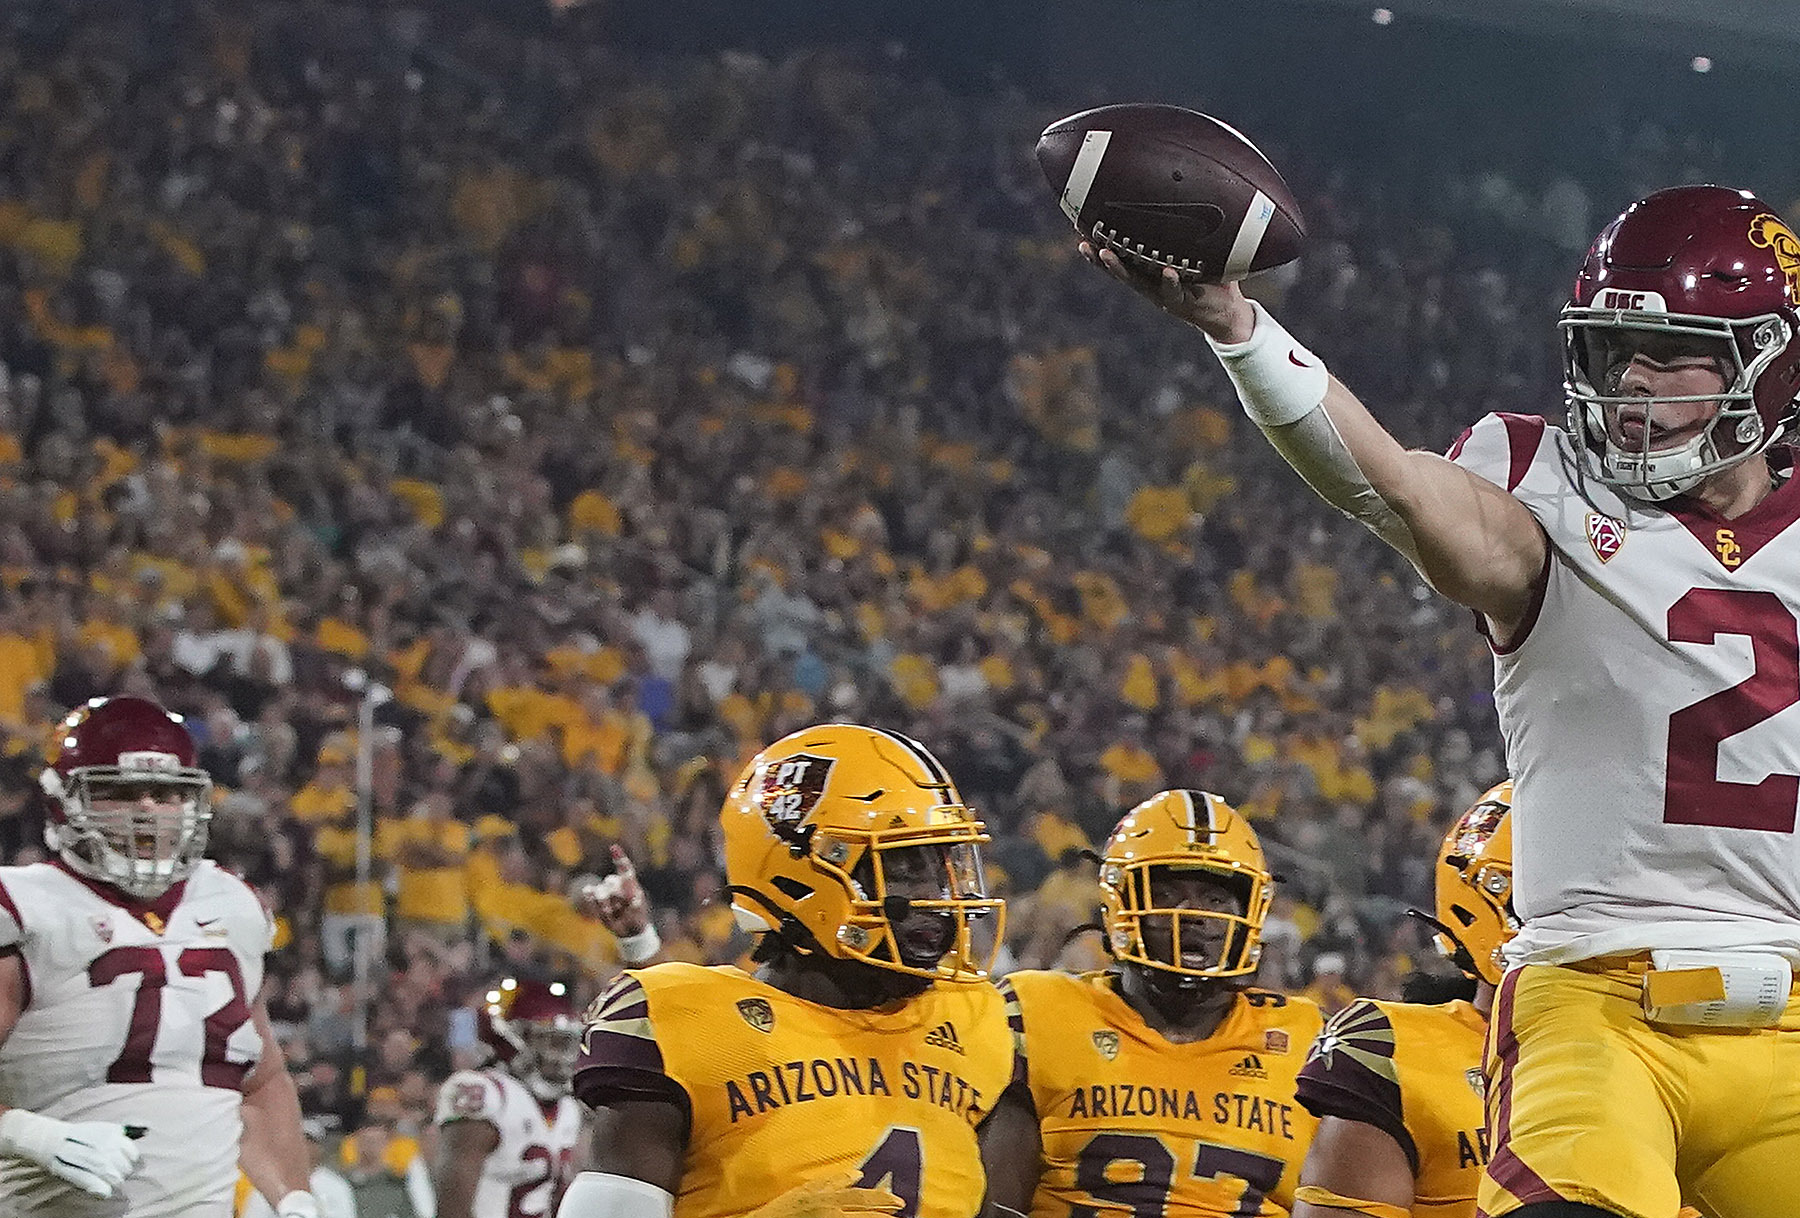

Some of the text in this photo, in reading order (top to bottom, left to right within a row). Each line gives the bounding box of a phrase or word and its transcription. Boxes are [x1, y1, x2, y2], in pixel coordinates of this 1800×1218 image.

[1604, 291, 1645, 310] USC
[1596, 532, 1620, 553] 12
[1715, 528, 1741, 567] SC
[1664, 587, 1800, 834] 2
[776, 761, 811, 785] PT
[769, 794, 804, 821] 42
[88, 946, 256, 1093] 72
[724, 1057, 986, 1129] ARIZONA STATE
[1067, 1085, 1295, 1140] ARIZONA STATE
